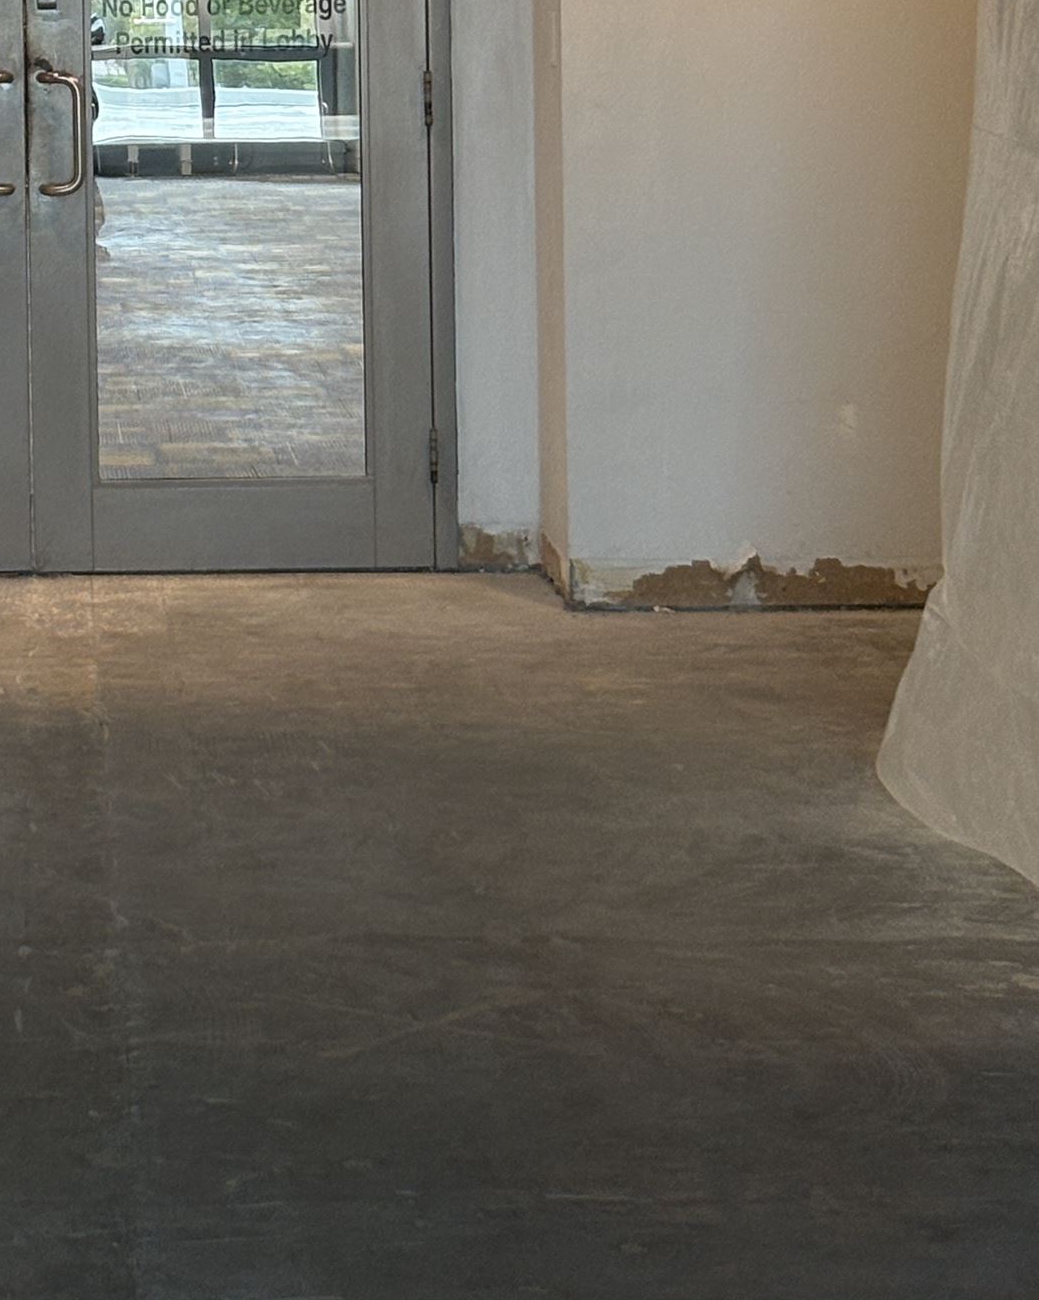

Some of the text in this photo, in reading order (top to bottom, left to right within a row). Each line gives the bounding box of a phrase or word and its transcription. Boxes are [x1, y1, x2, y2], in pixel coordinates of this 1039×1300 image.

[207, 0, 227, 16] or
[116, 29, 333, 57] Permitted in Lobby
